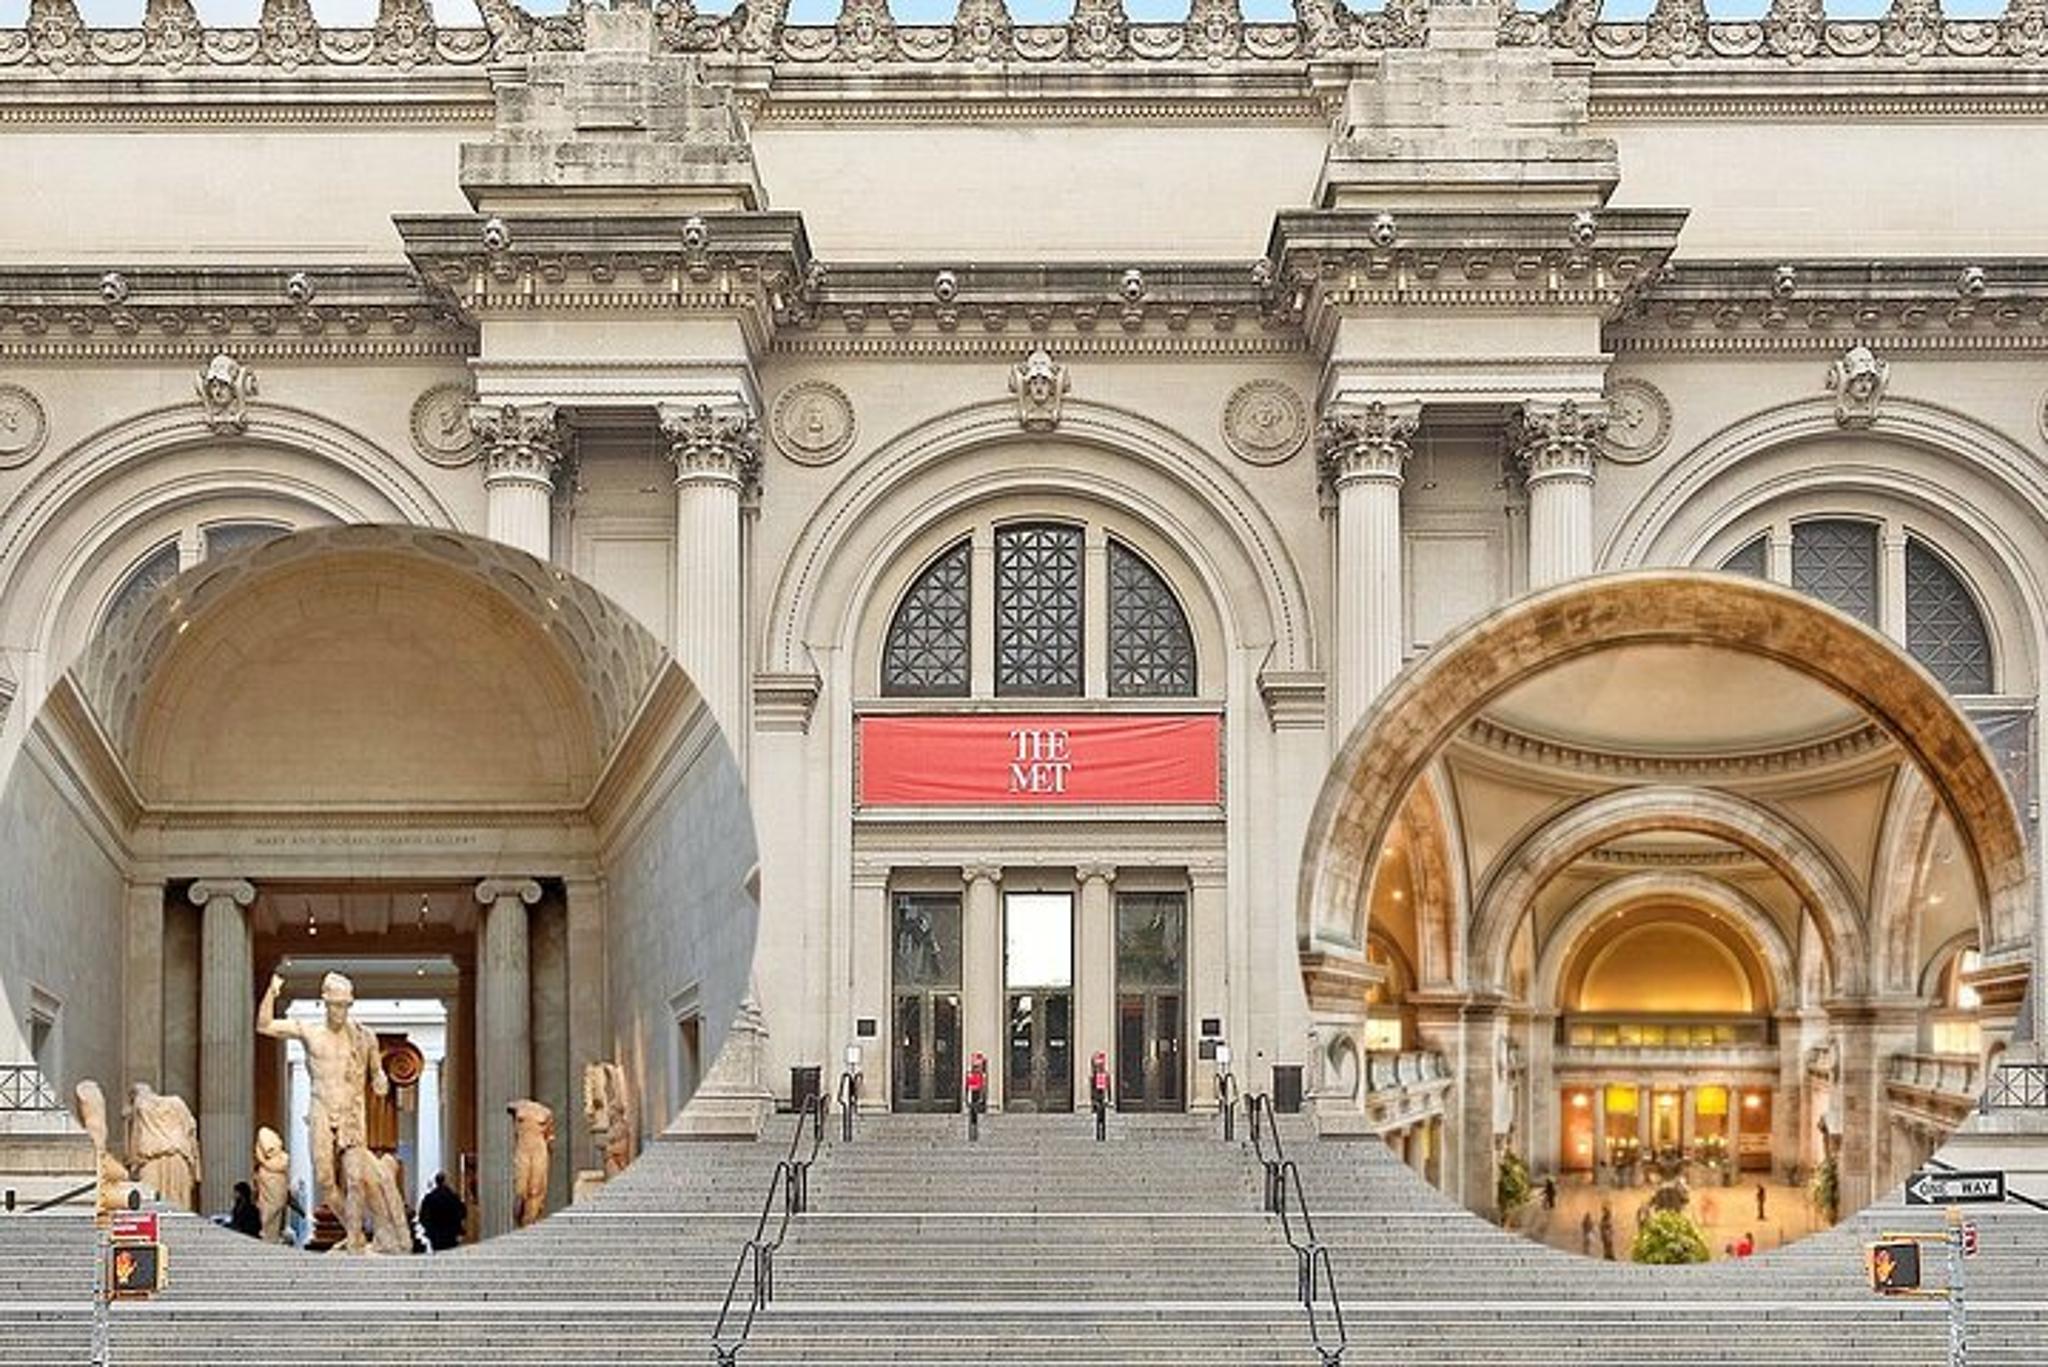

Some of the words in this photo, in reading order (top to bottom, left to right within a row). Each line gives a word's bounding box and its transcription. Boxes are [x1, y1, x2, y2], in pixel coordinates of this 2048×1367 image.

[1008, 729, 1071, 760] THE
[1008, 762, 1072, 792] MET
[1962, 1182, 1991, 1195] WAY
